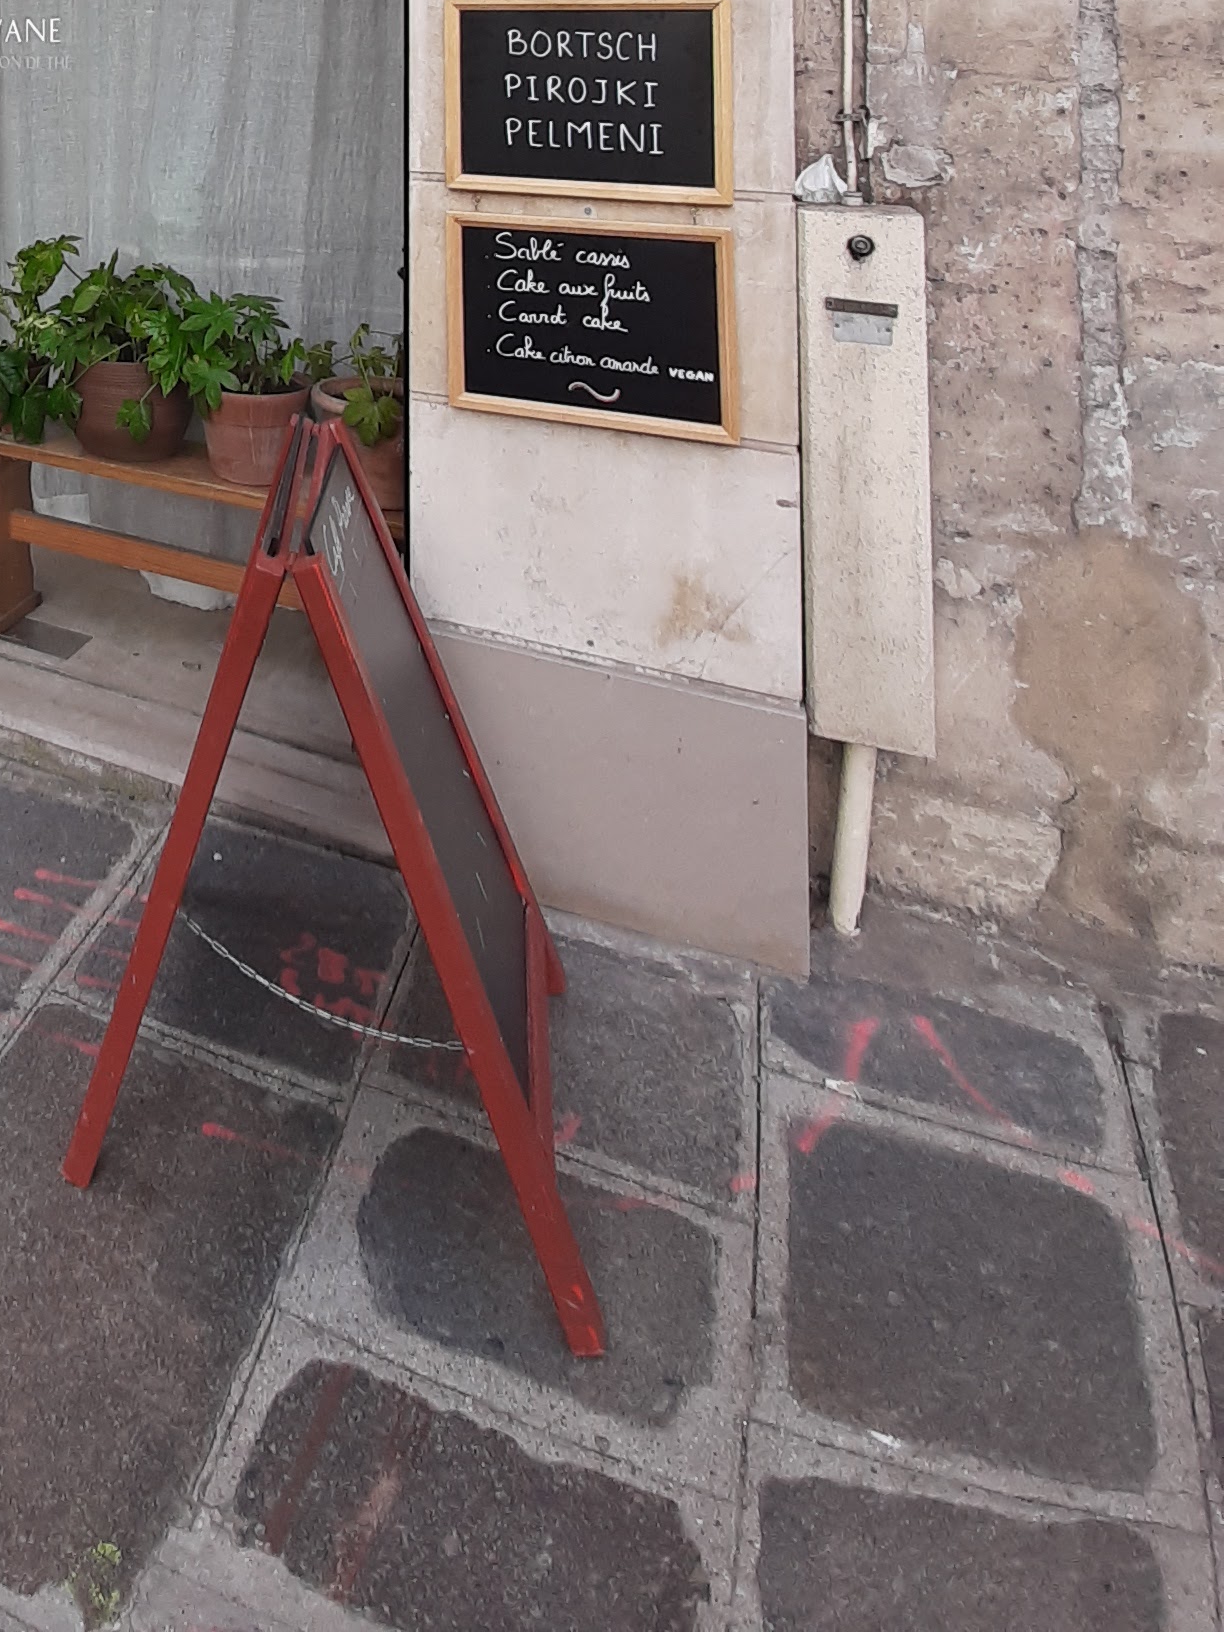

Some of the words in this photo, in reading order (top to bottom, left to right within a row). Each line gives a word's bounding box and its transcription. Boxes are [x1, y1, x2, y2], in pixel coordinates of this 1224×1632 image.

[506, 28, 658, 63] BORTSCH
[504, 72, 659, 109] PIROJKI
[504, 117, 665, 156] PELMENI
[493, 231, 565, 262] Sablé
[575, 248, 631, 270] cassis
[496, 268, 551, 294] Cake
[558, 282, 599, 297] aux
[599, 273, 652, 306] fruits
[498, 300, 568, 325] Carrot
[582, 304, 629, 333] cake
[495, 333, 546, 360] Cake
[549, 345, 597, 367] citron
[599, 355, 660, 375] amande
[667, 367, 715, 383] VEGAN
